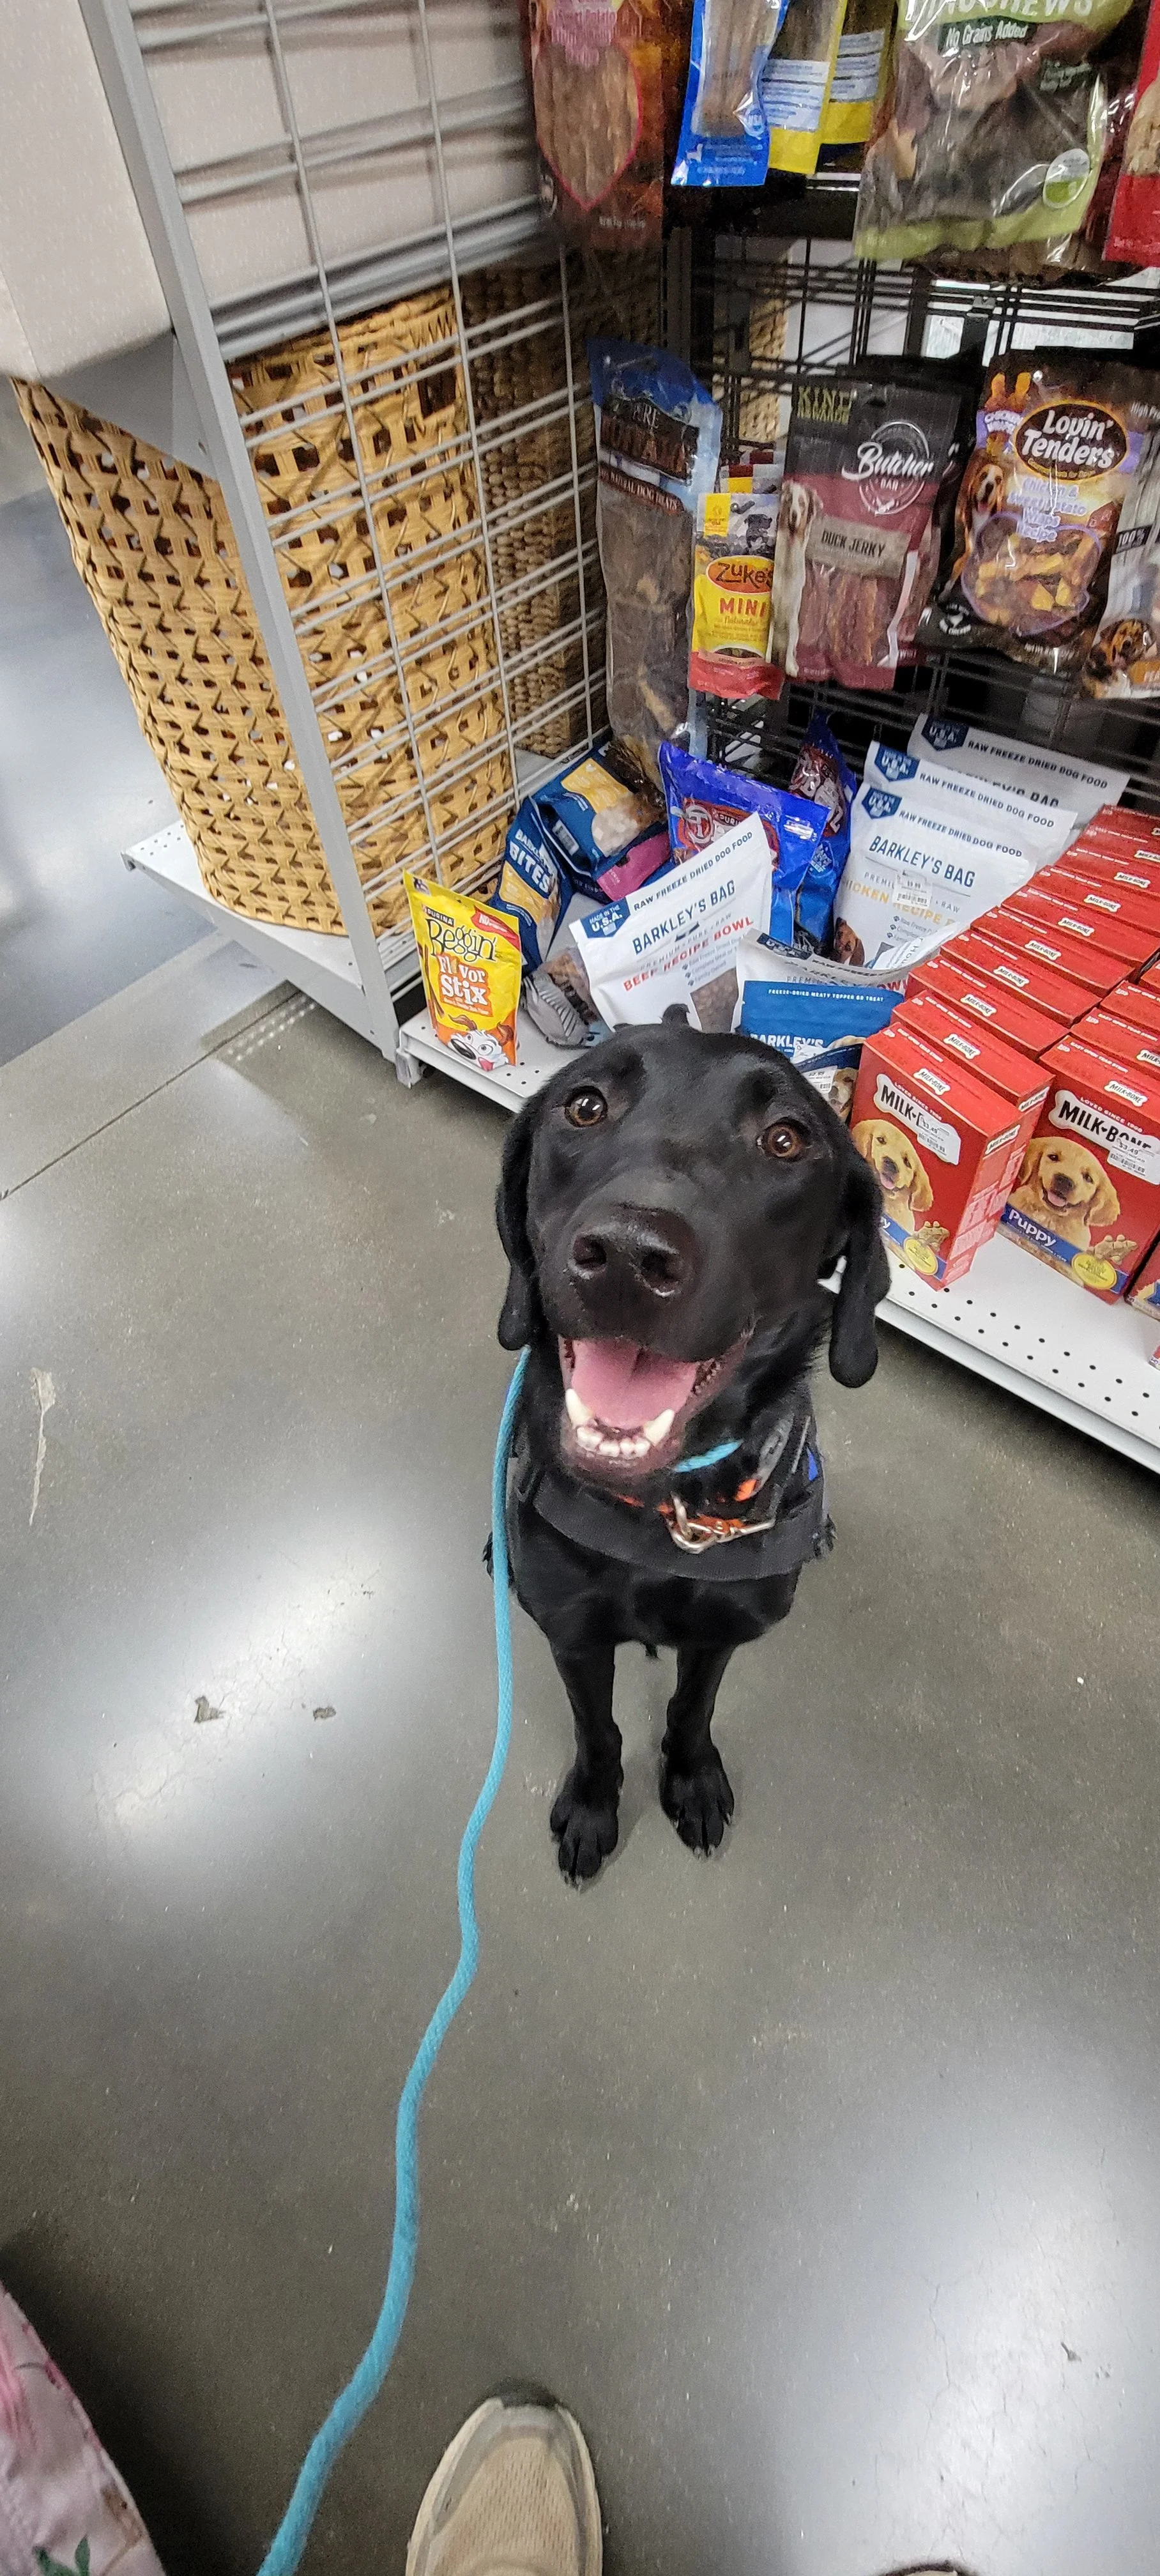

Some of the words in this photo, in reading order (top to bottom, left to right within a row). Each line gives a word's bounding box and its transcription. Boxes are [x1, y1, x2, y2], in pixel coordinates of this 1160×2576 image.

[1043, 410, 1114, 441] Lovin'
[841, 441, 935, 480] Butcher
[1022, 429, 1115, 468] Tenders
[821, 528, 848, 549] DUCK
[849, 537, 885, 558] JERKY
[1119, 528, 1145, 545] 100%
[720, 597, 766, 618] MINI
[968, 740, 989, 752] RAW
[991, 747, 1026, 763] FREEZE
[1028, 758, 1057, 771] DRIED
[1059, 766, 1079, 779] DOG
[1081, 774, 1108, 789] FOOD
[920, 772, 940, 785] RAW
[942, 781, 976, 798] FREEZE
[977, 794, 1004, 809] DRIED
[1006, 804, 1025, 818] DOG
[1027, 813, 1055, 828] FOOD
[899, 809, 917, 823] RAW
[917, 816, 947, 833] FREEZE
[948, 827, 972, 843] DRIED
[973, 836, 994, 850] DOG
[995, 844, 1023, 858] FOOD
[509, 840, 551, 893] BITES
[634, 896, 653, 911] RAW
[656, 877, 688, 900] FREEZE
[690, 859, 714, 880] DRIED
[715, 847, 731, 863] DOG
[732, 831, 752, 850] FOOD
[869, 836, 943, 874] BARKLEY'S
[944, 864, 976, 887] BAG
[427, 908, 453, 926] PURINA
[591, 911, 623, 932] U.S.A.
[632, 899, 706, 955] BARKLEY'S
[711, 880, 735, 907] BAG
[941, 901, 960, 914] RAW
[623, 969, 659, 992] BEEF
[663, 940, 710, 972] RECIPE
[714, 916, 754, 941] BOWL
[441, 974, 488, 1006] Stix
[1080, 1096, 1103, 1112] LOVED
[1104, 1109, 1126, 1124] SINCE
[1009, 1209, 1057, 1246] Puppy
